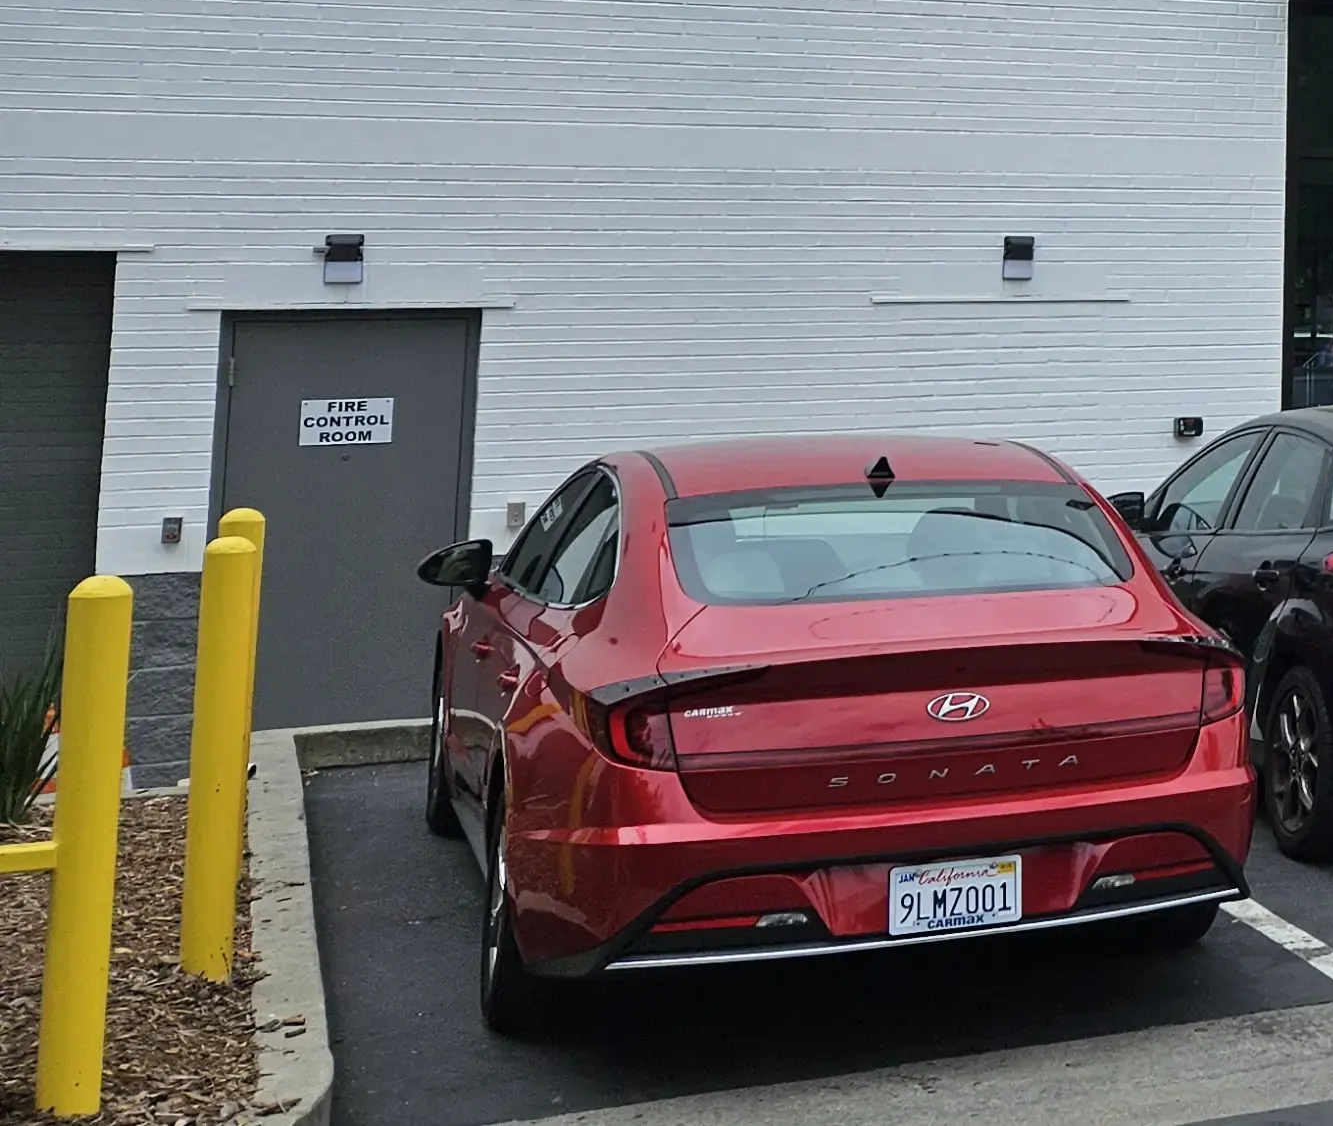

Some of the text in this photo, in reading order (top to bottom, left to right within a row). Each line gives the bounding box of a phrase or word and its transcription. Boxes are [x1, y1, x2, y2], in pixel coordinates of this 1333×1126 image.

[327, 401, 368, 412] FIRE
[303, 415, 389, 428] CONTROL
[319, 430, 372, 443] ROOM
[828, 754, 1079, 787] SONATA
[899, 873, 916, 884] JAN
[919, 867, 997, 886] California
[900, 881, 1012, 924] 9LMZ001
